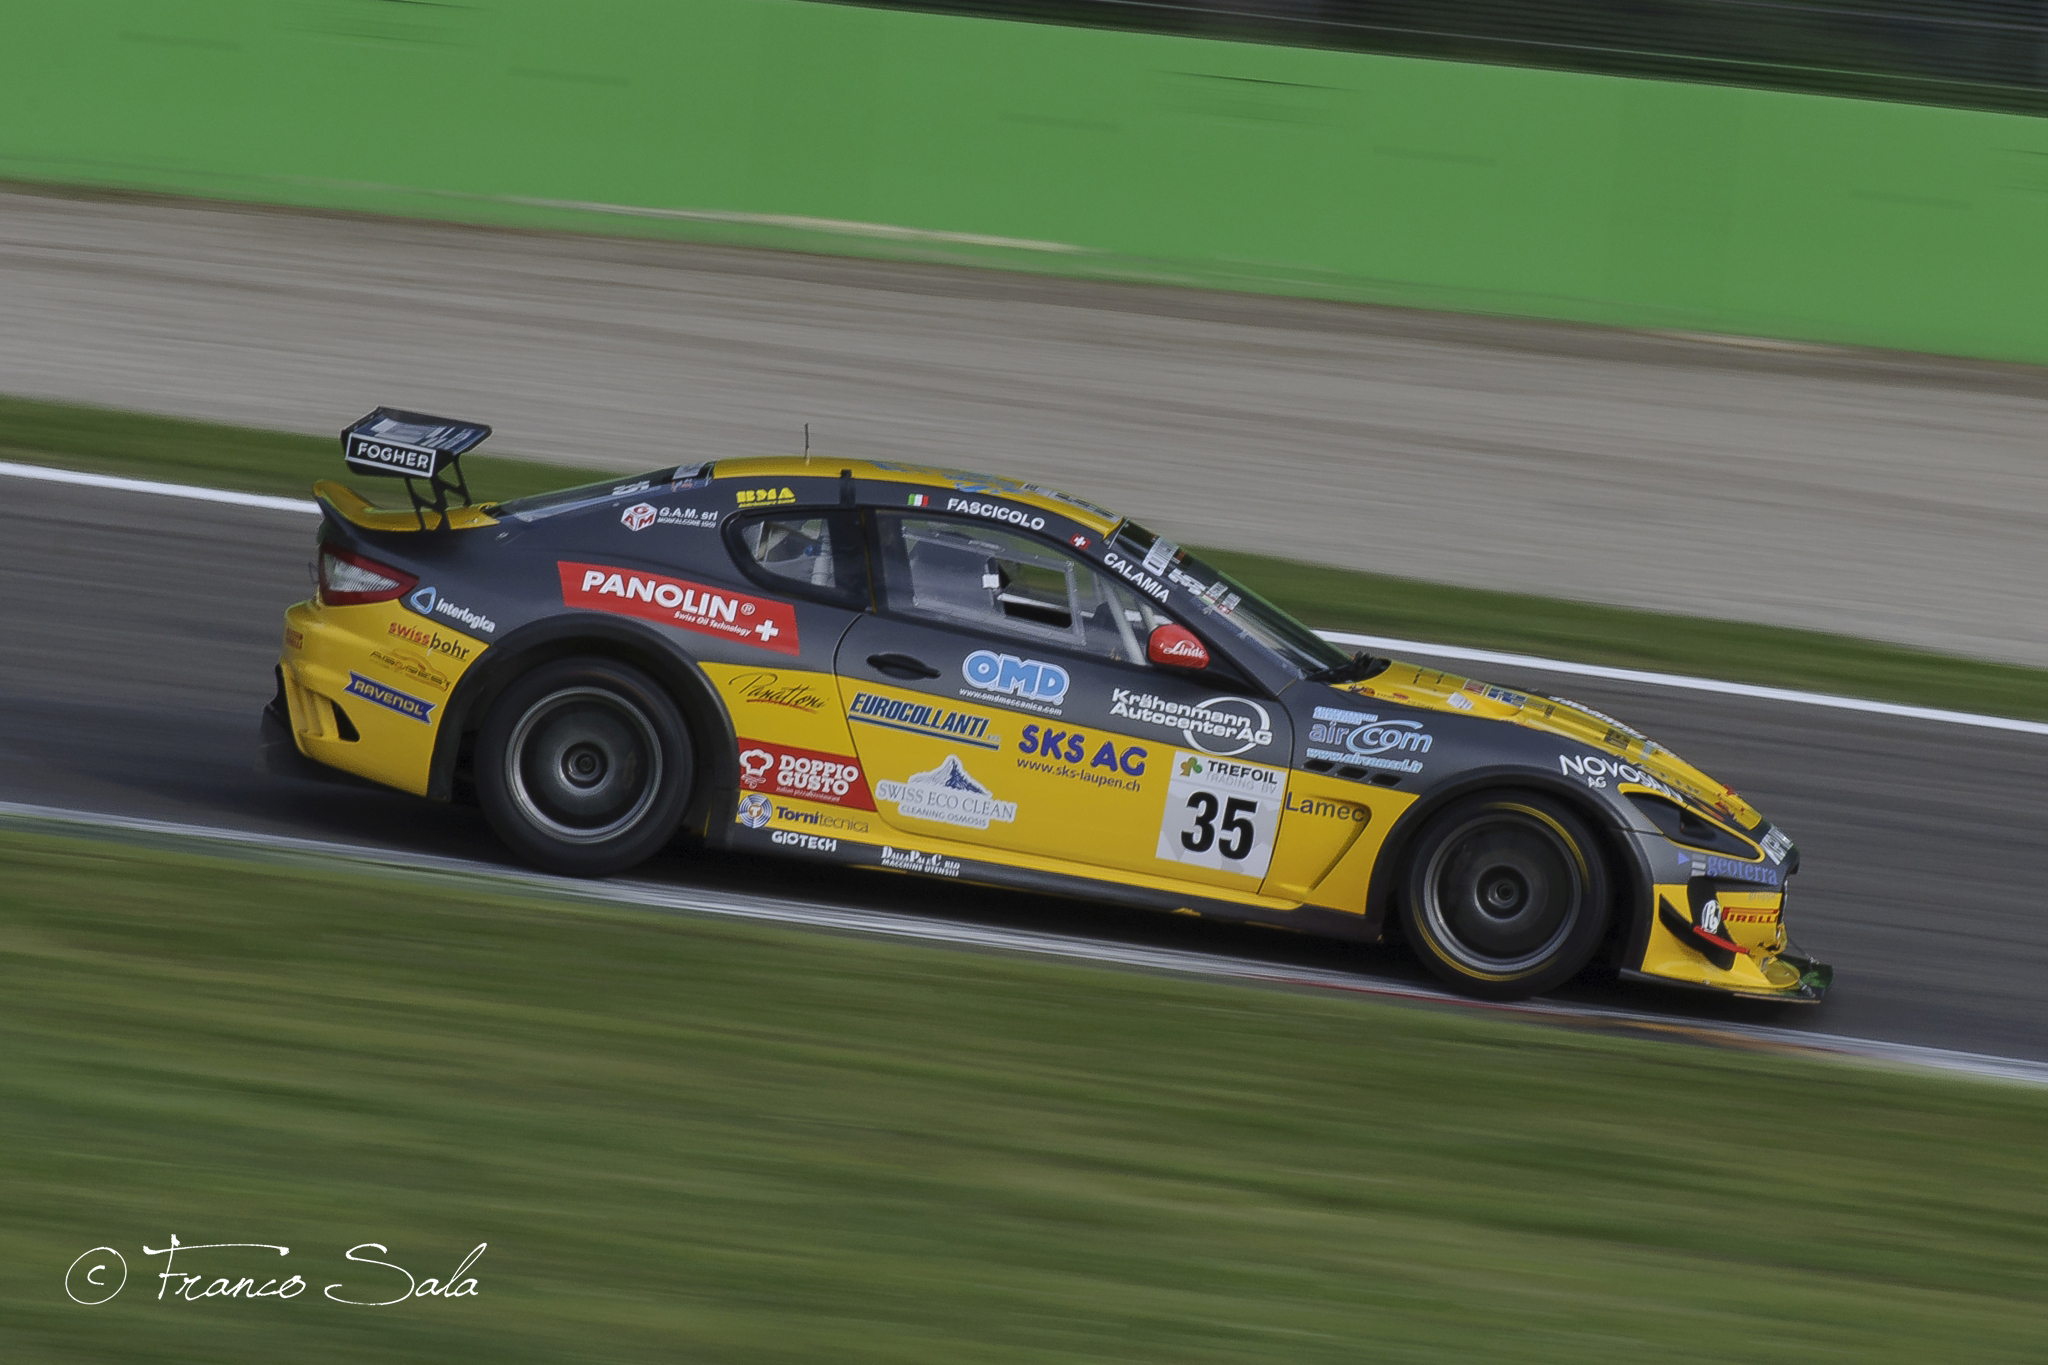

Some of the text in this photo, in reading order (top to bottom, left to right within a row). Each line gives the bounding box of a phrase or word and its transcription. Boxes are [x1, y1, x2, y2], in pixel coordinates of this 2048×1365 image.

[357, 442, 430, 469] FOGHER
[701, 511, 718, 521] srl
[947, 498, 1045, 531] FASCICOLO
[1104, 552, 1170, 603] CALAMIA
[436, 598, 496, 633] Interlogica
[673, 611, 752, 637] Swiss Oil Technology
[1162, 639, 1206, 660] Linde
[962, 650, 1070, 705] OMD
[353, 679, 424, 716] RAVENOL
[959, 688, 1063, 716] www.omdmeccanica.com
[1112, 688, 1251, 727] Krähenmann
[850, 691, 990, 738] EUROCOLLANTI
[1018, 724, 1148, 776] SKS AG
[778, 754, 859, 782] DOPPIO
[1017, 758, 1141, 792] www.sks-laupen.ch
[1205, 772, 1254, 791] TRADING
[1207, 760, 1278, 784] TREFOIL
[1587, 776, 1607, 788] AG
[776, 770, 849, 795] GUSTO
[878, 783, 1015, 819] SWISS ECO CLEAN
[1286, 792, 1366, 822] Lamec
[776, 806, 869, 833] Tornitecnica
[901, 805, 987, 827] CLEANING OSMOSIS
[1181, 791, 1258, 860] 35
[771, 831, 838, 852] GIOTECH
[881, 858, 960, 878] MACCHINE UTENSILI
[1707, 855, 1779, 886] geoterra
[1721, 906, 1779, 923] PIRELLI
